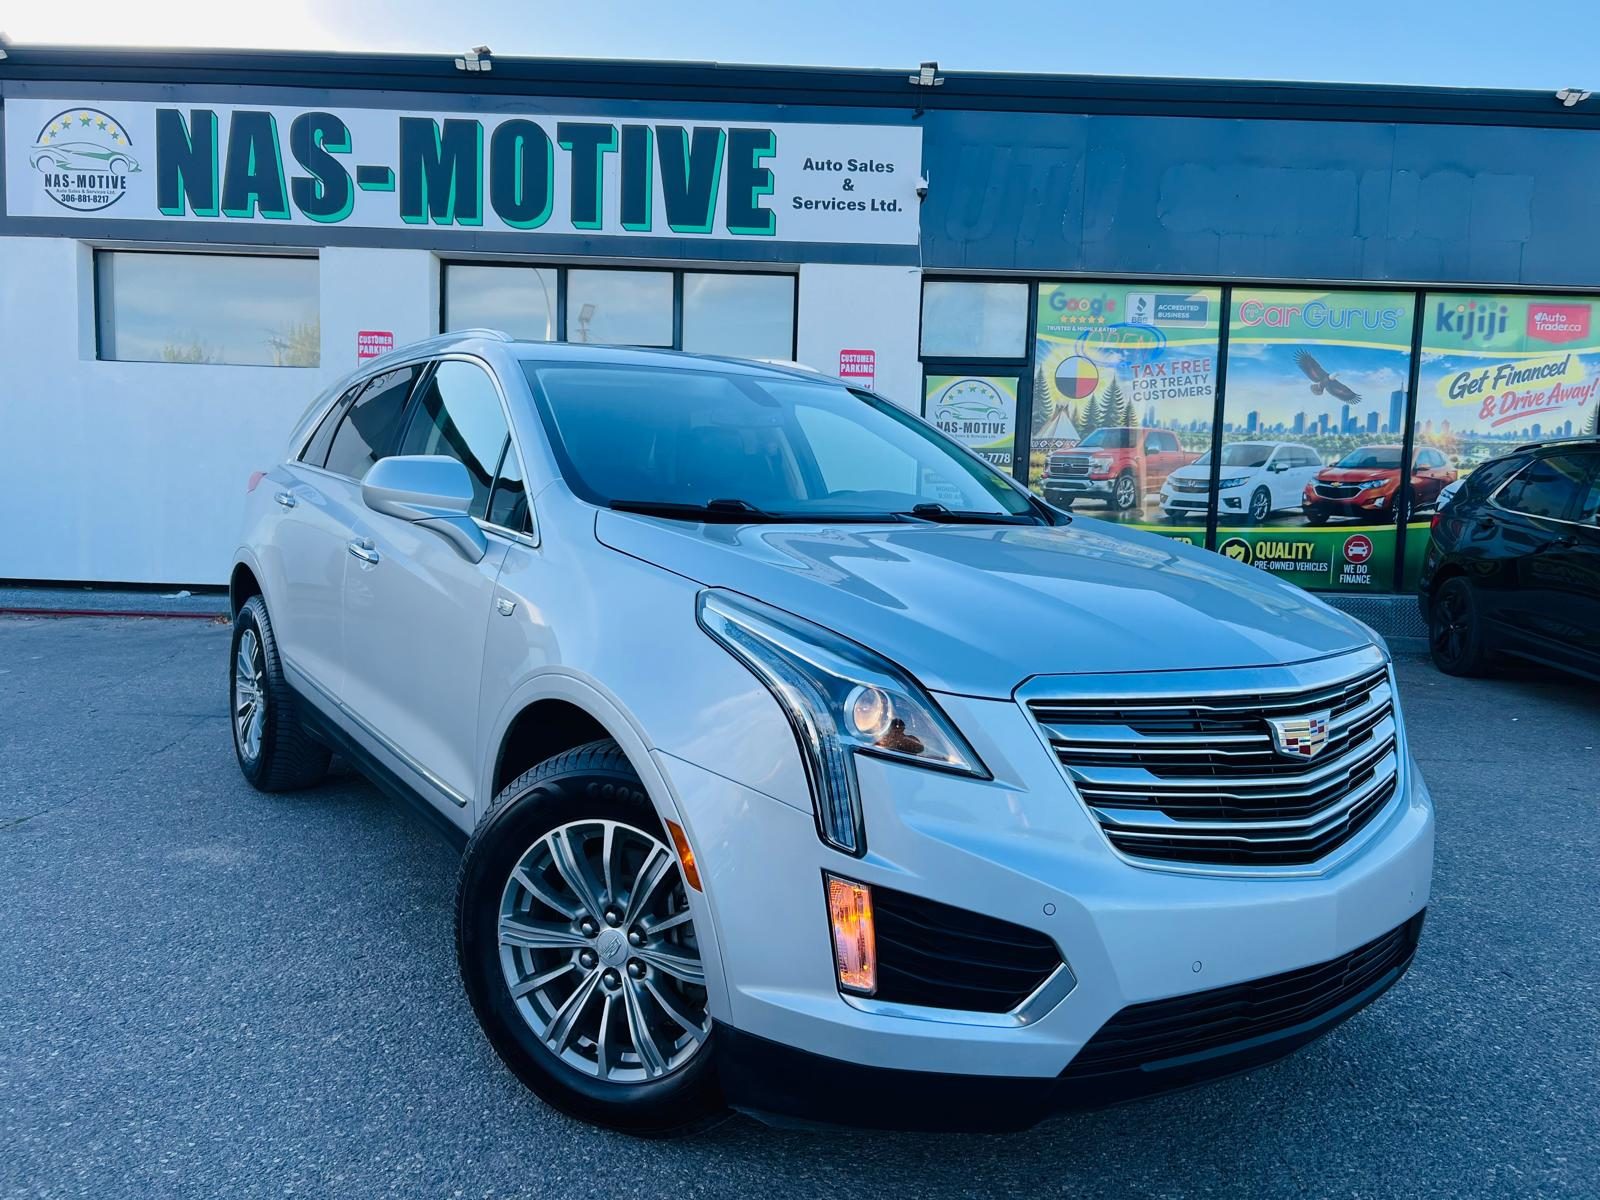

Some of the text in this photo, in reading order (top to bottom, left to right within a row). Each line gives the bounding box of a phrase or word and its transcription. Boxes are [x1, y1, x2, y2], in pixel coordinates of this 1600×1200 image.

[156, 108, 777, 236] NAS-MOTIVE
[803, 157, 895, 173] Auto Sales
[44, 173, 126, 189] NAS-MOTIVE
[842, 178, 855, 192] &
[792, 196, 903, 212] Services Ltd.
[1157, 304, 1200, 312] ACCREDITED
[1239, 299, 1399, 330] CarGurus
[1436, 302, 1509, 341] kijiji
[1541, 312, 1567, 322] Auto
[1535, 321, 1582, 332] Trader.ca
[359, 335, 393, 345] CUSTOMER
[841, 354, 874, 363] CUSTOMER
[840, 363, 874, 373] PARKING
[1131, 359, 1211, 379] TAX FREE
[1132, 375, 1208, 391] FOR TREATY
[1448, 353, 1571, 400] Get Financed
[1133, 385, 1212, 402] CUSTOMERS
[1478, 377, 1599, 420] & Drive Away!
[936, 421, 1006, 434] NAS-MOTIVE
[1255, 541, 1315, 560] QUALITY
[1254, 560, 1329, 572] PRE-OWNED VEHICLES
[1343, 564, 1368, 574] WE DO
[1339, 574, 1371, 584] FINANCE
